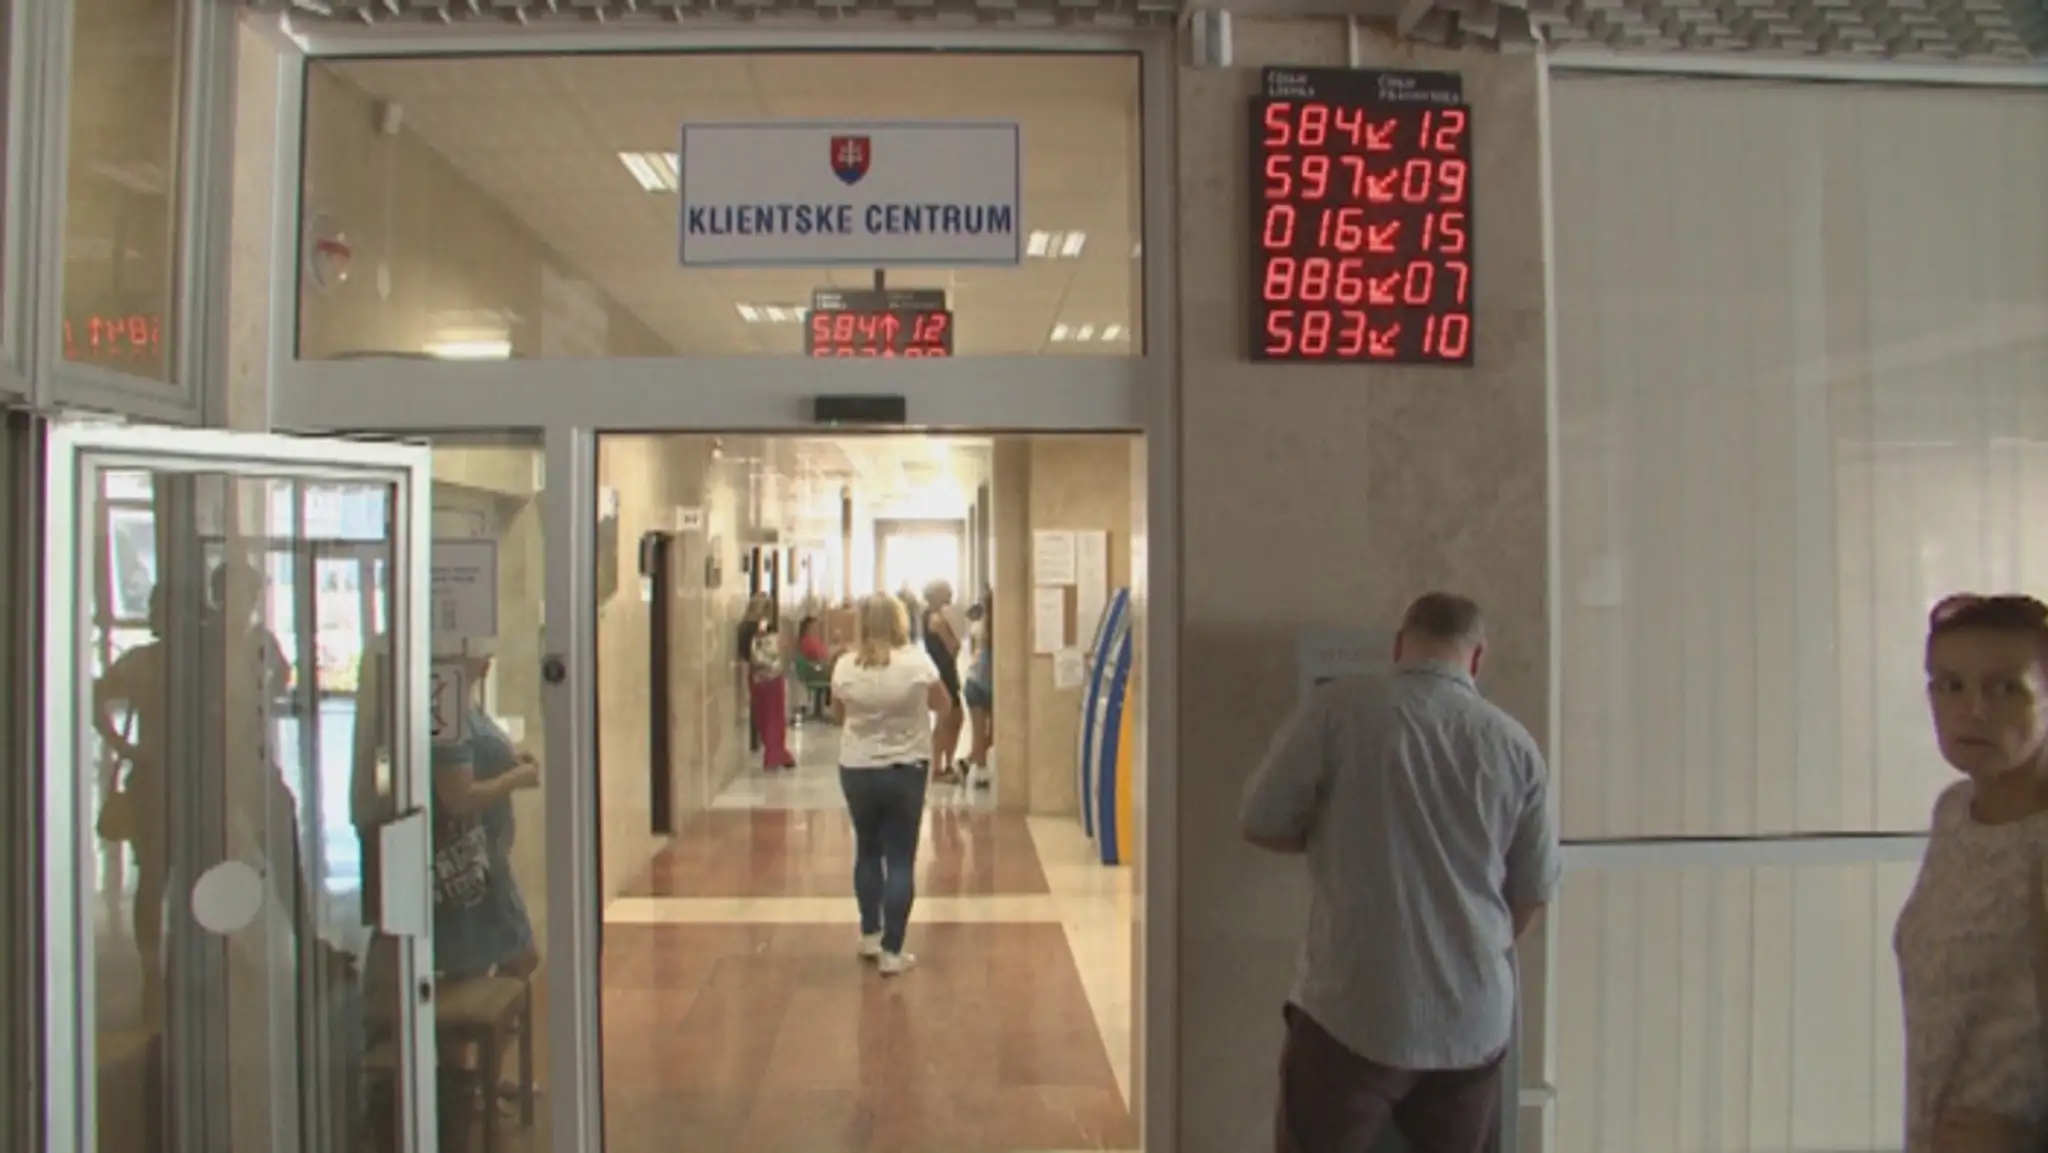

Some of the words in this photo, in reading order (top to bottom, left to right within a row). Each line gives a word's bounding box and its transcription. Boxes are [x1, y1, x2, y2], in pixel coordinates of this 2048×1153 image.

[1264, 102, 1363, 145] 584
[1420, 110, 1465, 150] 12
[1265, 154, 1365, 199] 597
[1402, 158, 1467, 202] 09
[688, 204, 853, 235] KLIENTSKE
[865, 204, 1012, 234] CENTRUM
[1264, 204, 1364, 251] 016
[1422, 212, 1465, 252] 15
[1264, 256, 1364, 302] 886
[1403, 261, 1468, 304] 07
[812, 314, 877, 341] 584
[913, 314, 947, 341] 12
[1265, 310, 1366, 354] 583
[1423, 313, 1469, 358] 10
